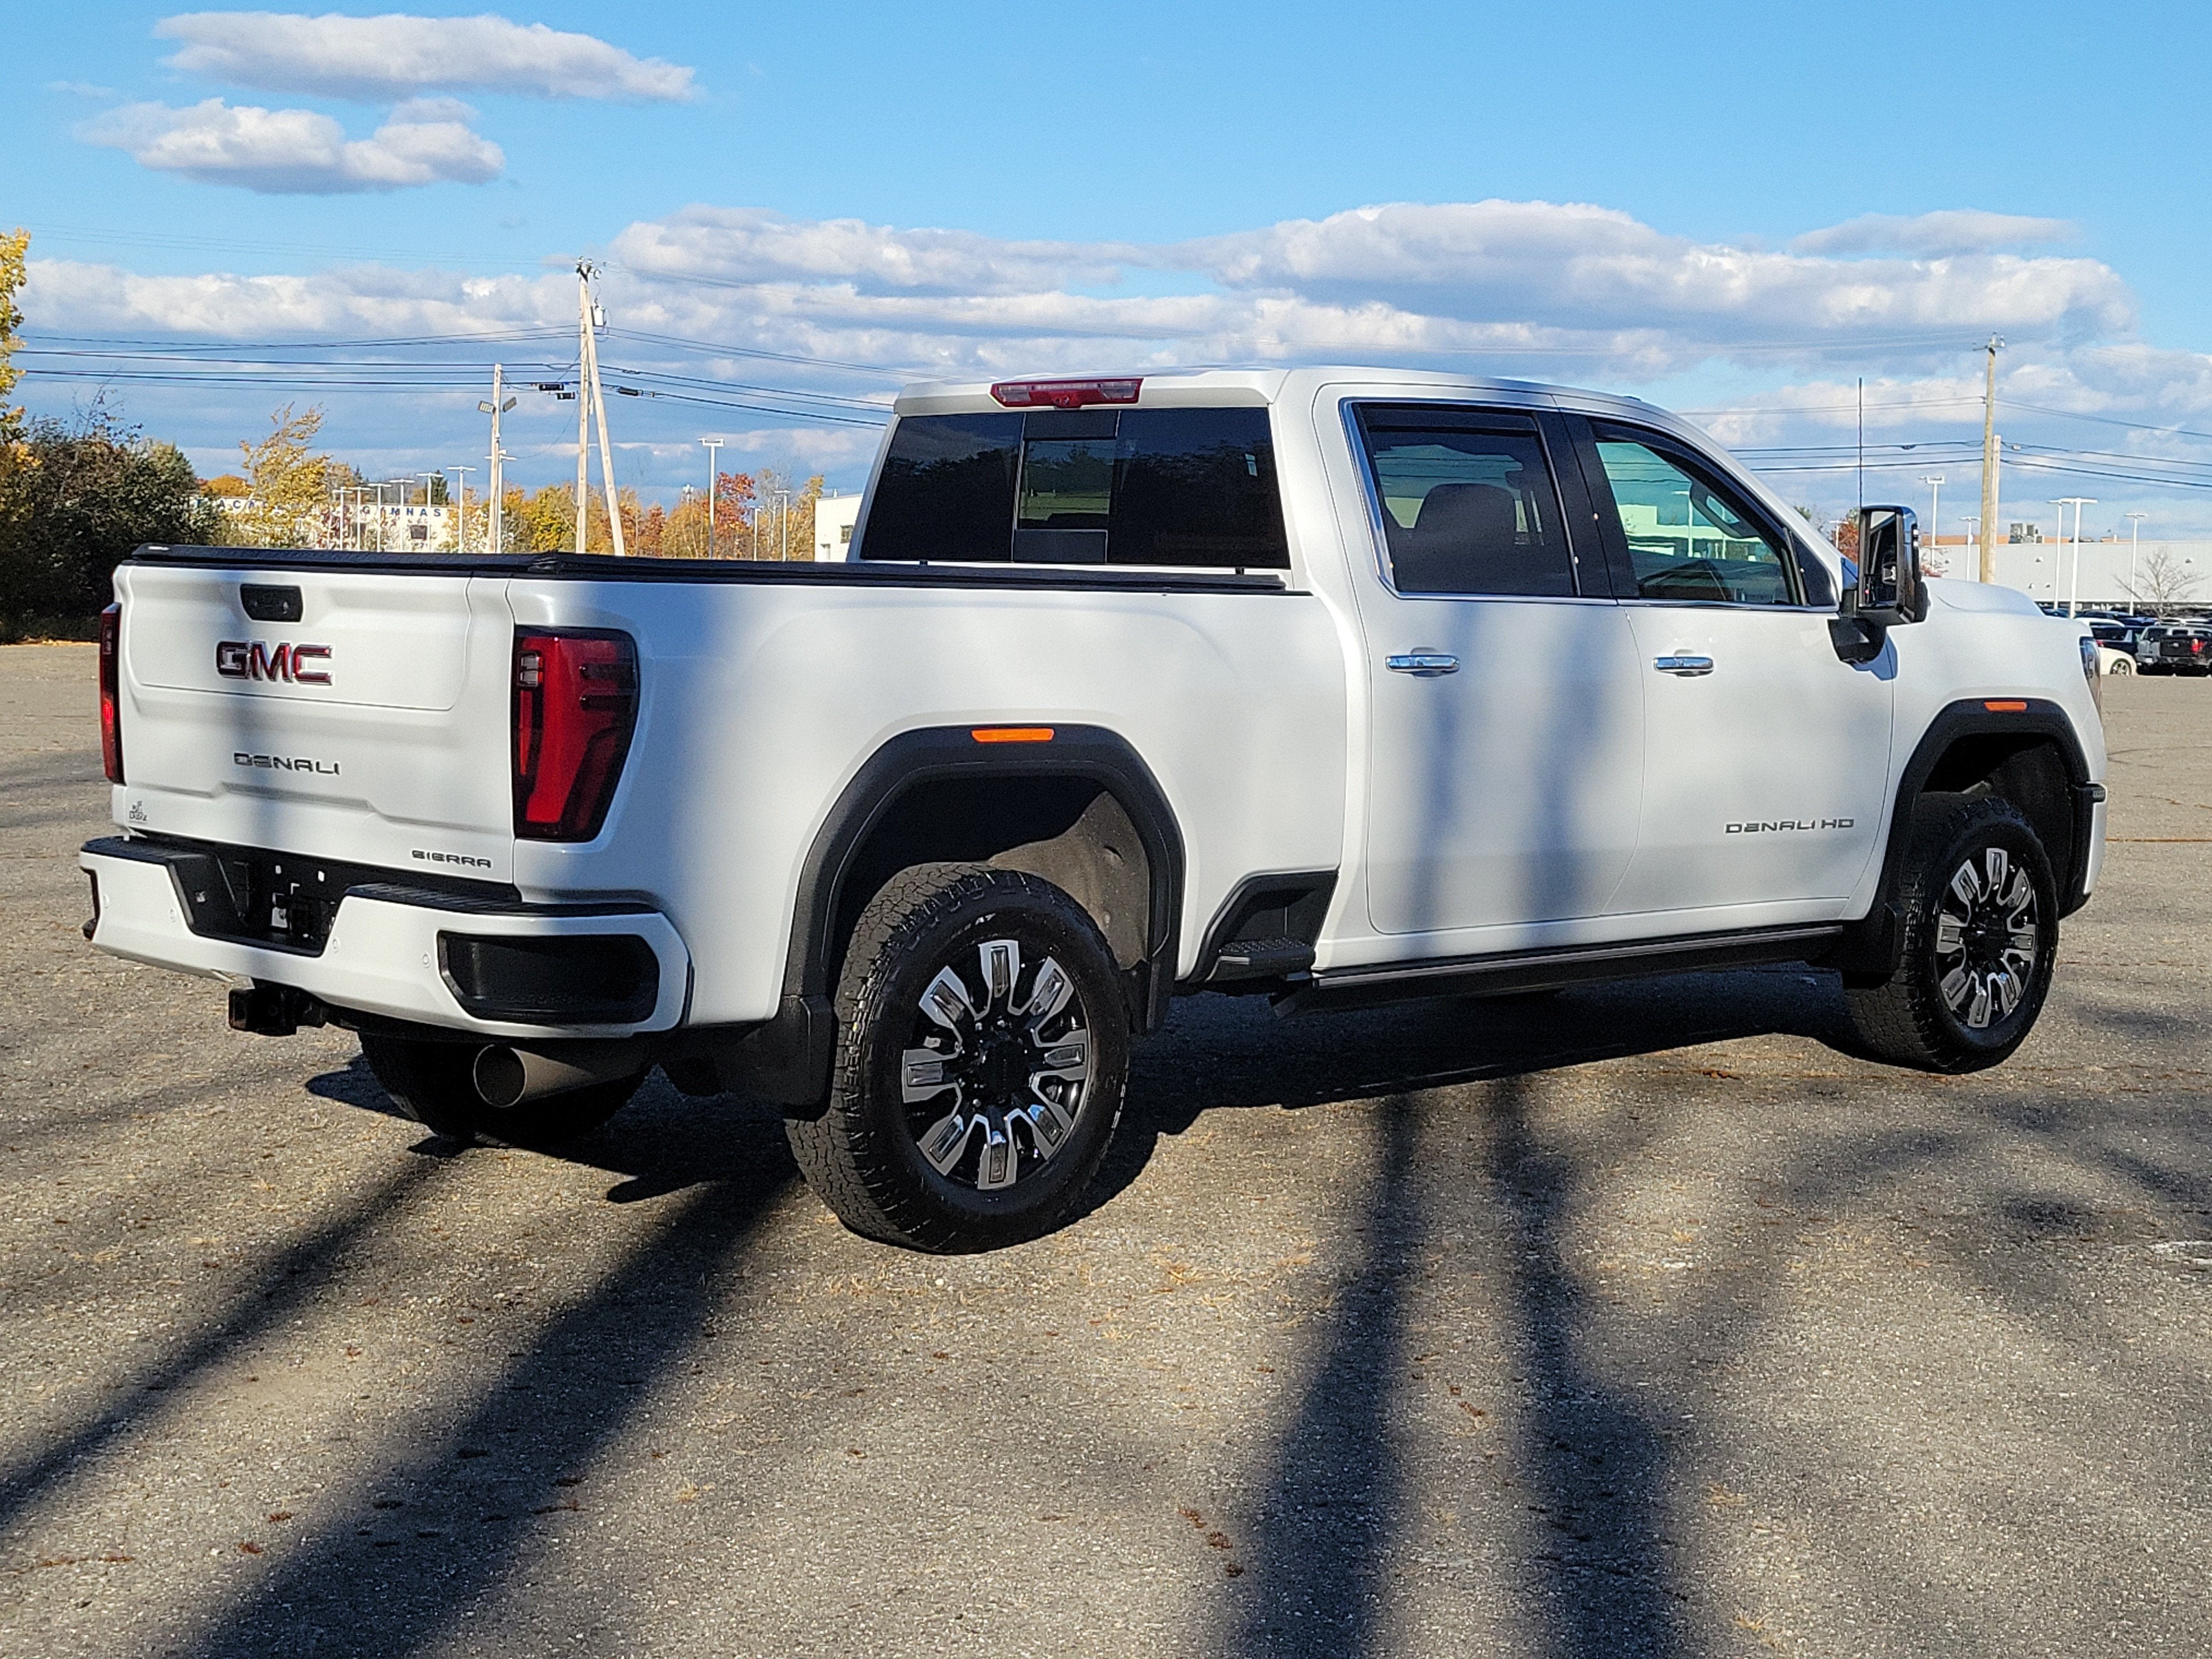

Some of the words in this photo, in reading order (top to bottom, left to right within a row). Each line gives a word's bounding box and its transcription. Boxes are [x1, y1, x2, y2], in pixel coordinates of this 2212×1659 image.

[216, 640, 332, 686] GMC
[234, 753, 340, 775] DENALI
[1725, 820, 1815, 833] DENALI
[1821, 819, 1854, 829] HD
[412, 850, 492, 868] SIERRA
